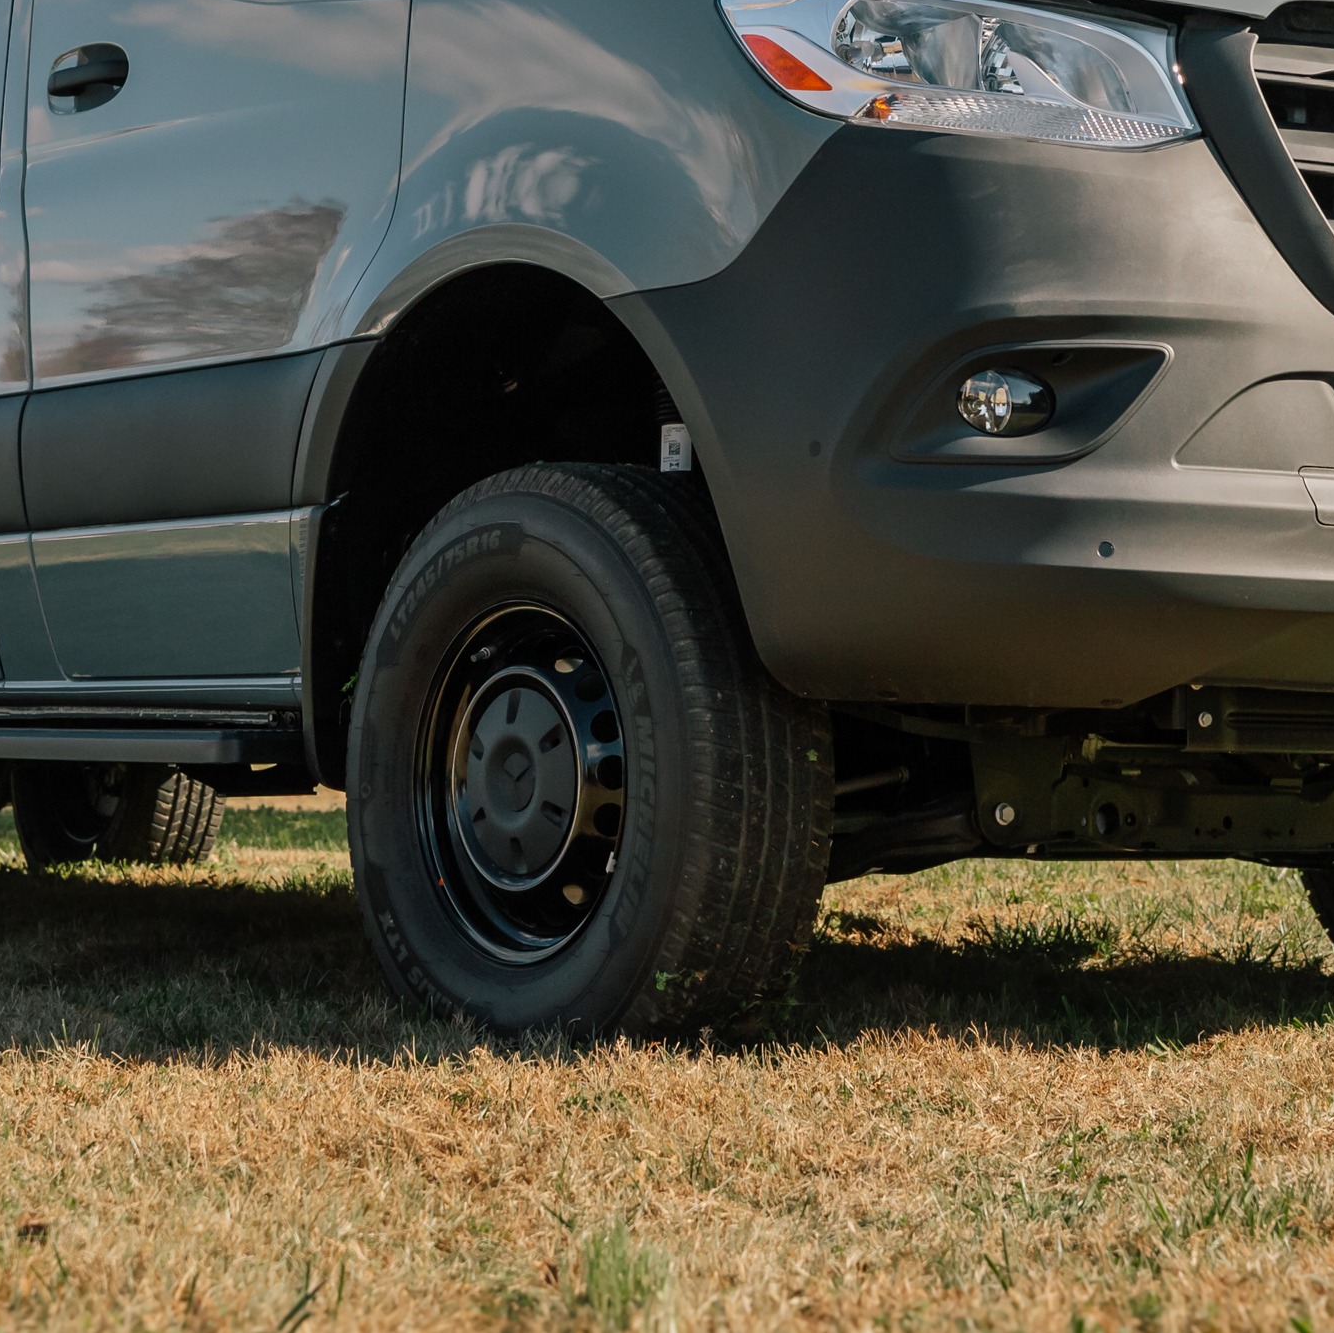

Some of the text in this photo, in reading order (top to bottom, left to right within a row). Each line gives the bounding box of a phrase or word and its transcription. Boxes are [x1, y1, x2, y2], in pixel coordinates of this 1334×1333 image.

[389, 529, 502, 641] LT245/75R16
[614, 714, 656, 939] MICHELIN
[378, 909, 409, 964] LTX
